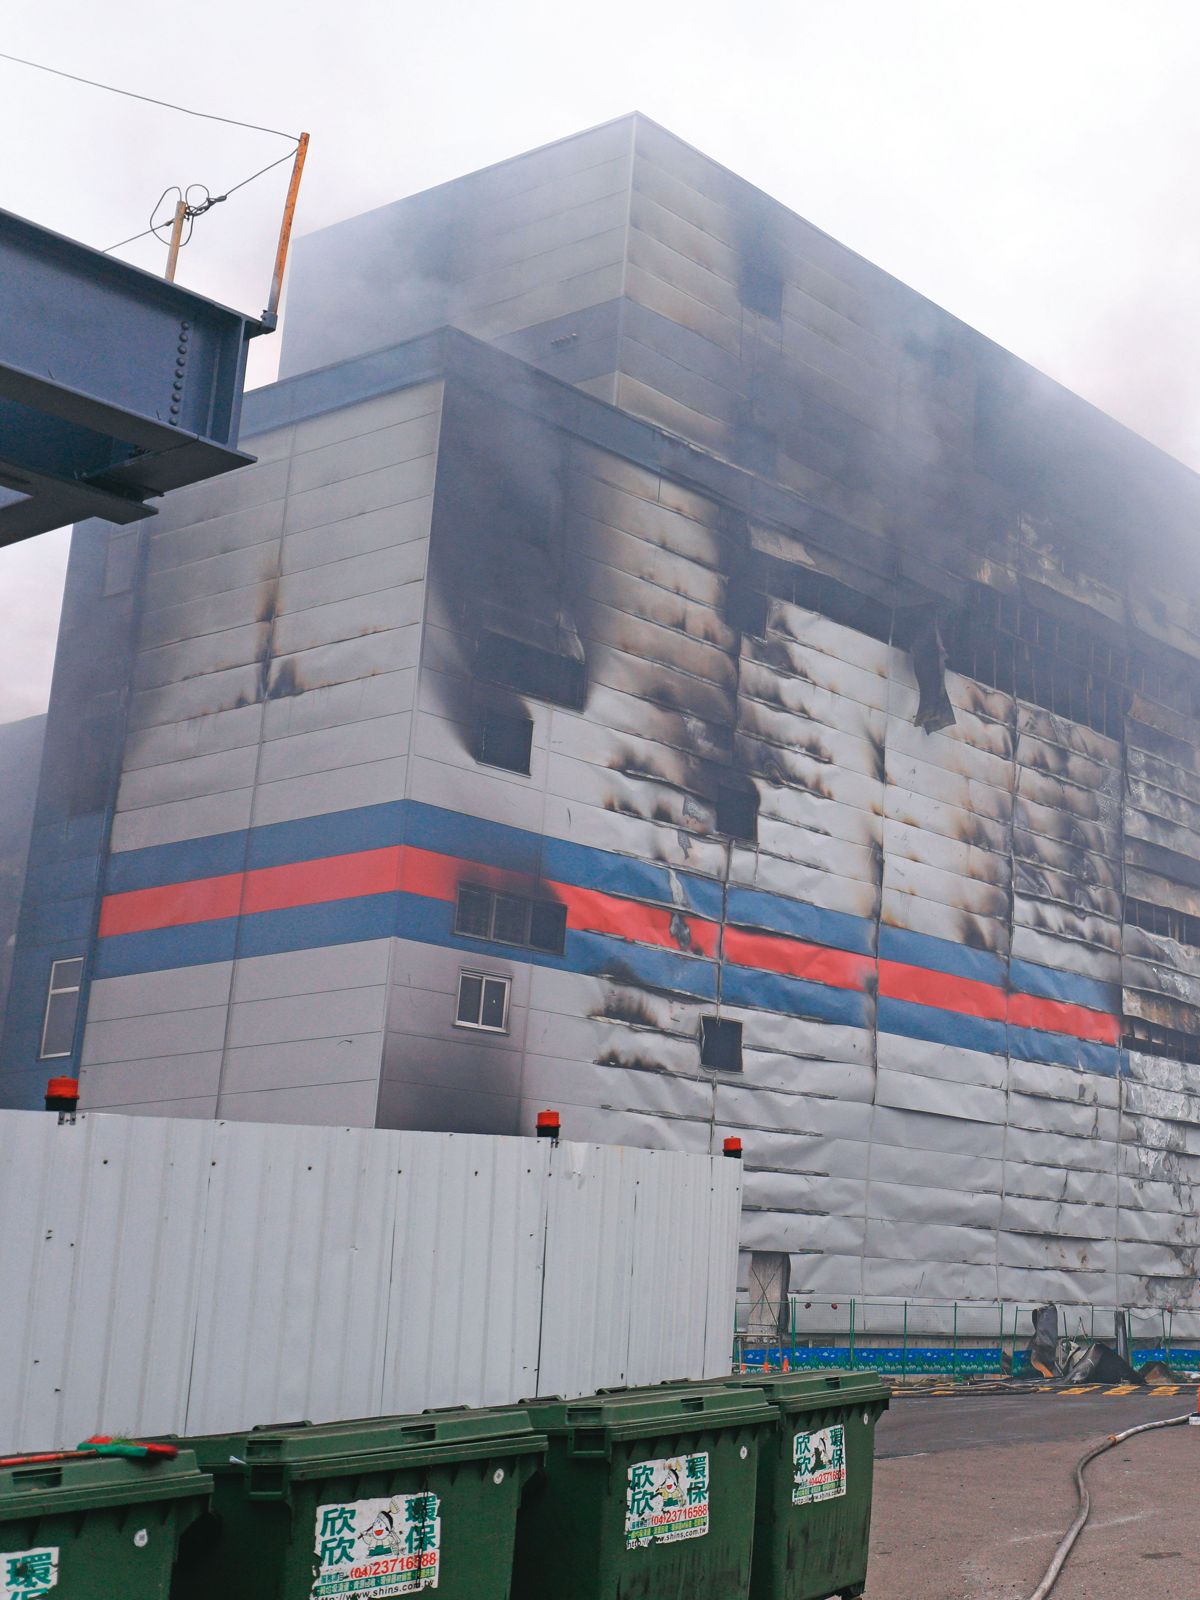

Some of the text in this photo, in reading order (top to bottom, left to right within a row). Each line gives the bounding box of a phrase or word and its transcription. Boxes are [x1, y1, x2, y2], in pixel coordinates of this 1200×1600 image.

[685, 1455, 707, 1506] 環保
[795, 1434, 812, 1477] 欣欣
[629, 1464, 655, 1518] 欣欣
[651, 1504, 708, 1526] (04)23716588
[319, 1506, 357, 1568] 欣欣
[404, 1494, 438, 1555] 環保
